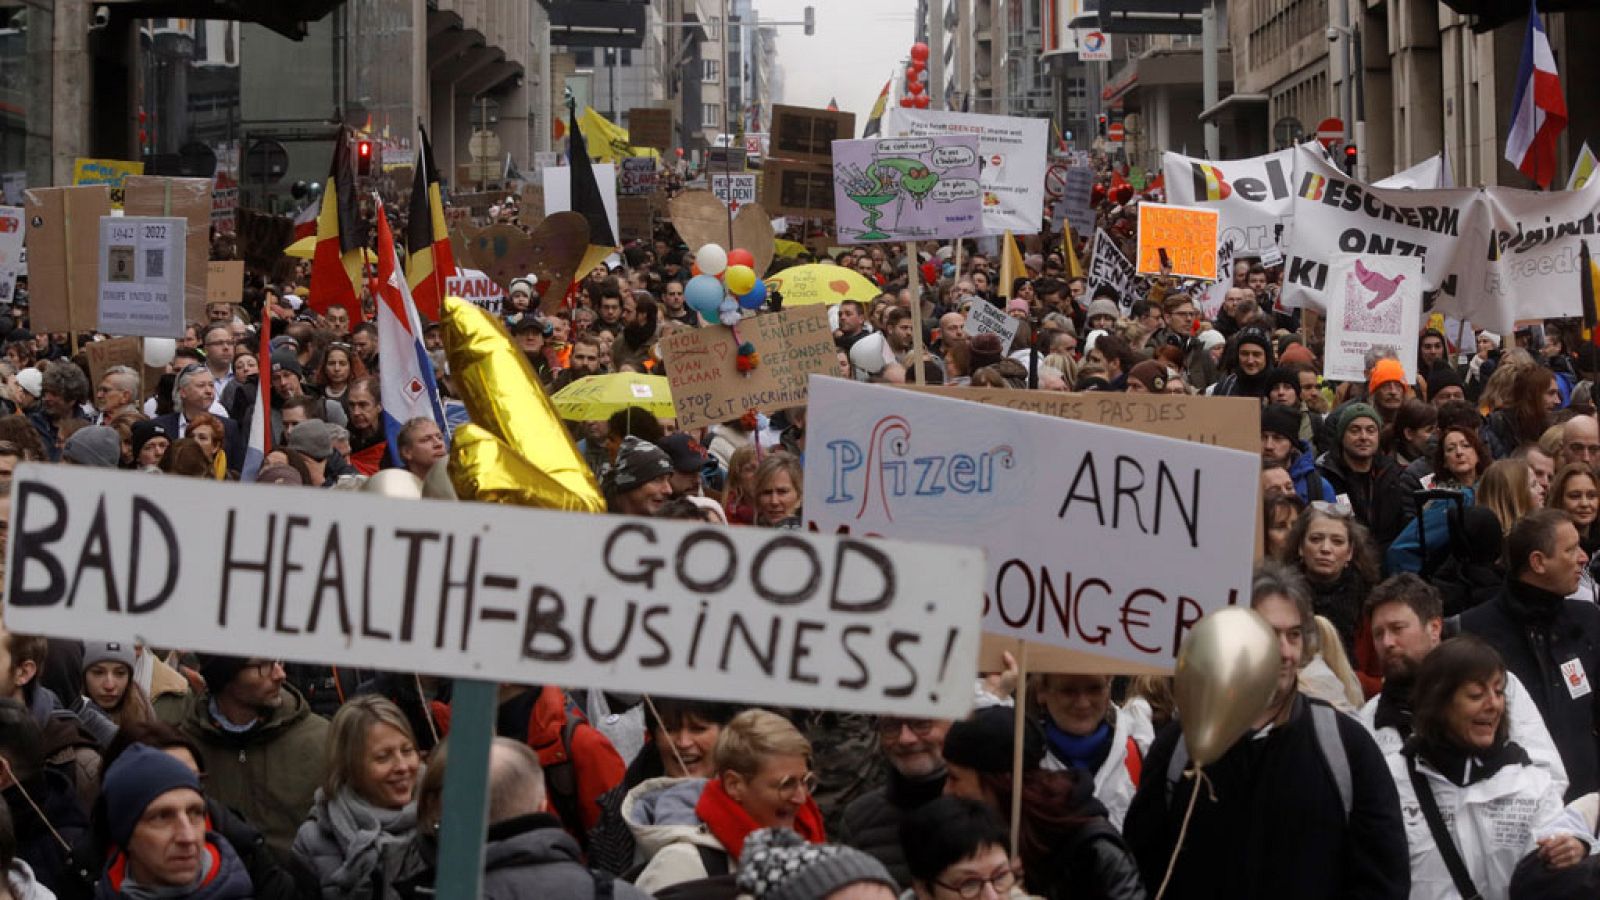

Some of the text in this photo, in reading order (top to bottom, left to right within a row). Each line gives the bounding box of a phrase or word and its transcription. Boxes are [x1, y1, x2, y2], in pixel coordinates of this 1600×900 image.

[1298, 171, 1460, 236] BESCHERM
[145, 225, 167, 239] 2022
[757, 313, 788, 328] EEN
[760, 317, 828, 340] KNUFFEL
[762, 341, 833, 366] GEZONDER
[671, 367, 722, 388] ELKAAR
[674, 359, 701, 374] VAN
[679, 391, 713, 411] STOP
[1098, 399, 1137, 423] PAS
[1145, 402, 1187, 423] DES
[682, 412, 696, 426] DE
[1057, 450, 1202, 548] ARN
[9, 480, 181, 614] BAD
